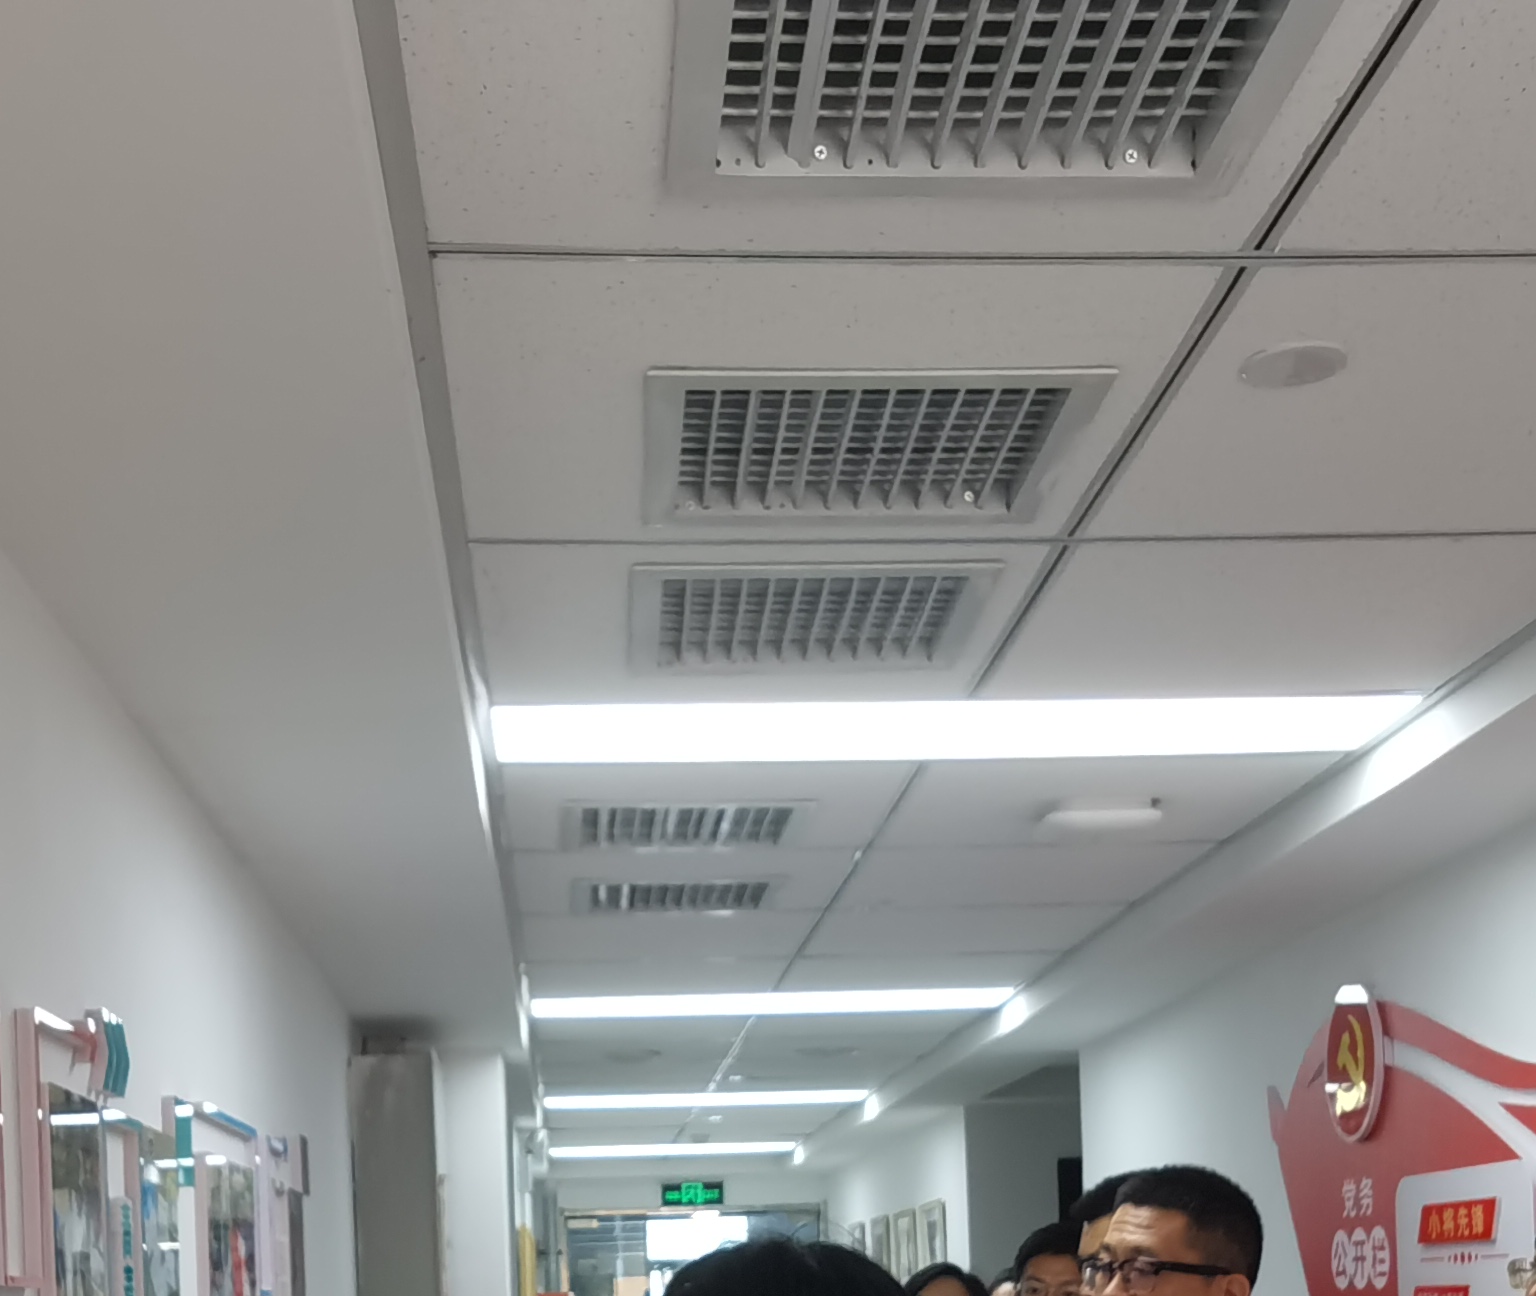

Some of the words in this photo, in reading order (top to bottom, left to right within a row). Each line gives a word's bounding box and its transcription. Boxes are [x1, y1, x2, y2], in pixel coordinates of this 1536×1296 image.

[1341, 1176, 1374, 1219] 党务
[1427, 1203, 1485, 1239] 小将先锋
[1332, 1230, 1389, 1287] 公开栏
